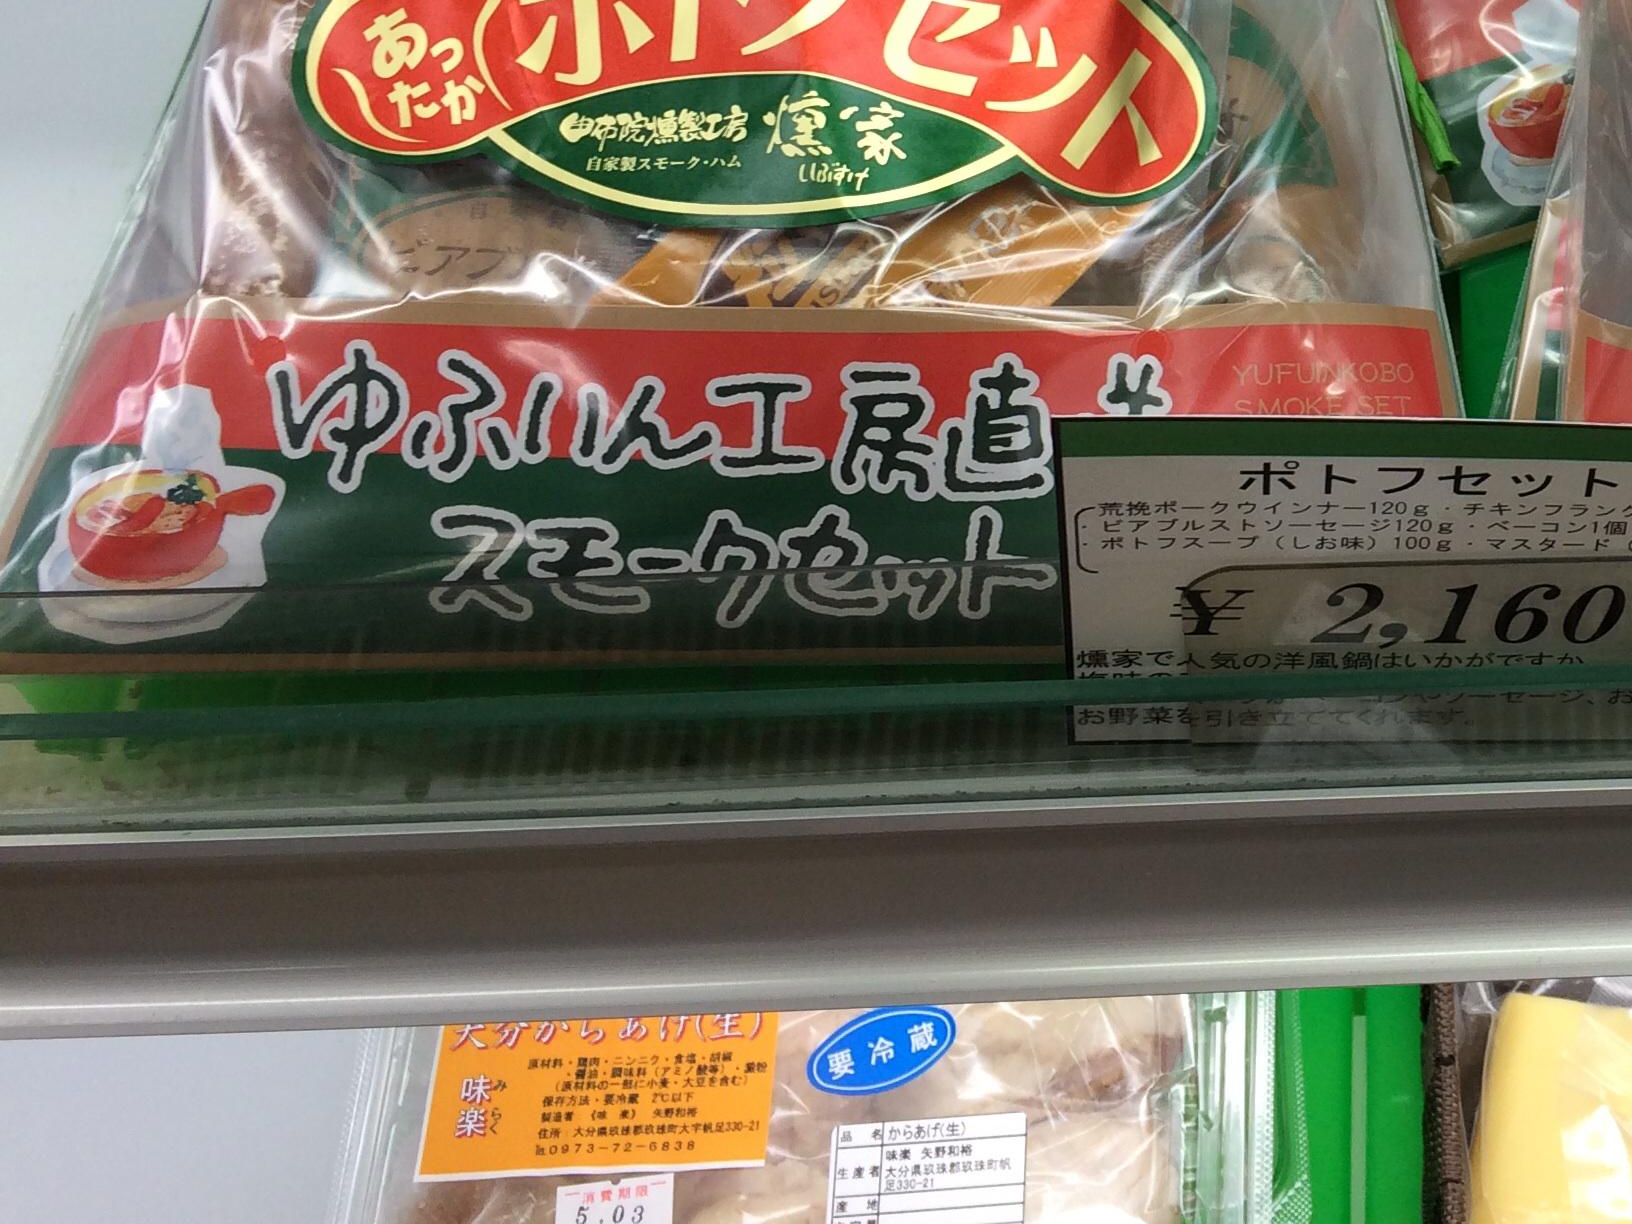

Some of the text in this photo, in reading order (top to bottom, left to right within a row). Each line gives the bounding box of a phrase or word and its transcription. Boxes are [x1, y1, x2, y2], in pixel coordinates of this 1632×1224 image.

[586, 156, 742, 172] 自家製スモーク・ハム
[1356, 395, 1411, 417] SET
[1239, 461, 1618, 497] ポトフセット
[430, 506, 1057, 627] スモークセット
[1310, 584, 1626, 649] 2,160
[826, 1022, 939, 1081] 要冷蔵
[455, 1075, 492, 1138] 味楽
[582, 1185, 649, 1205] 消費期限
